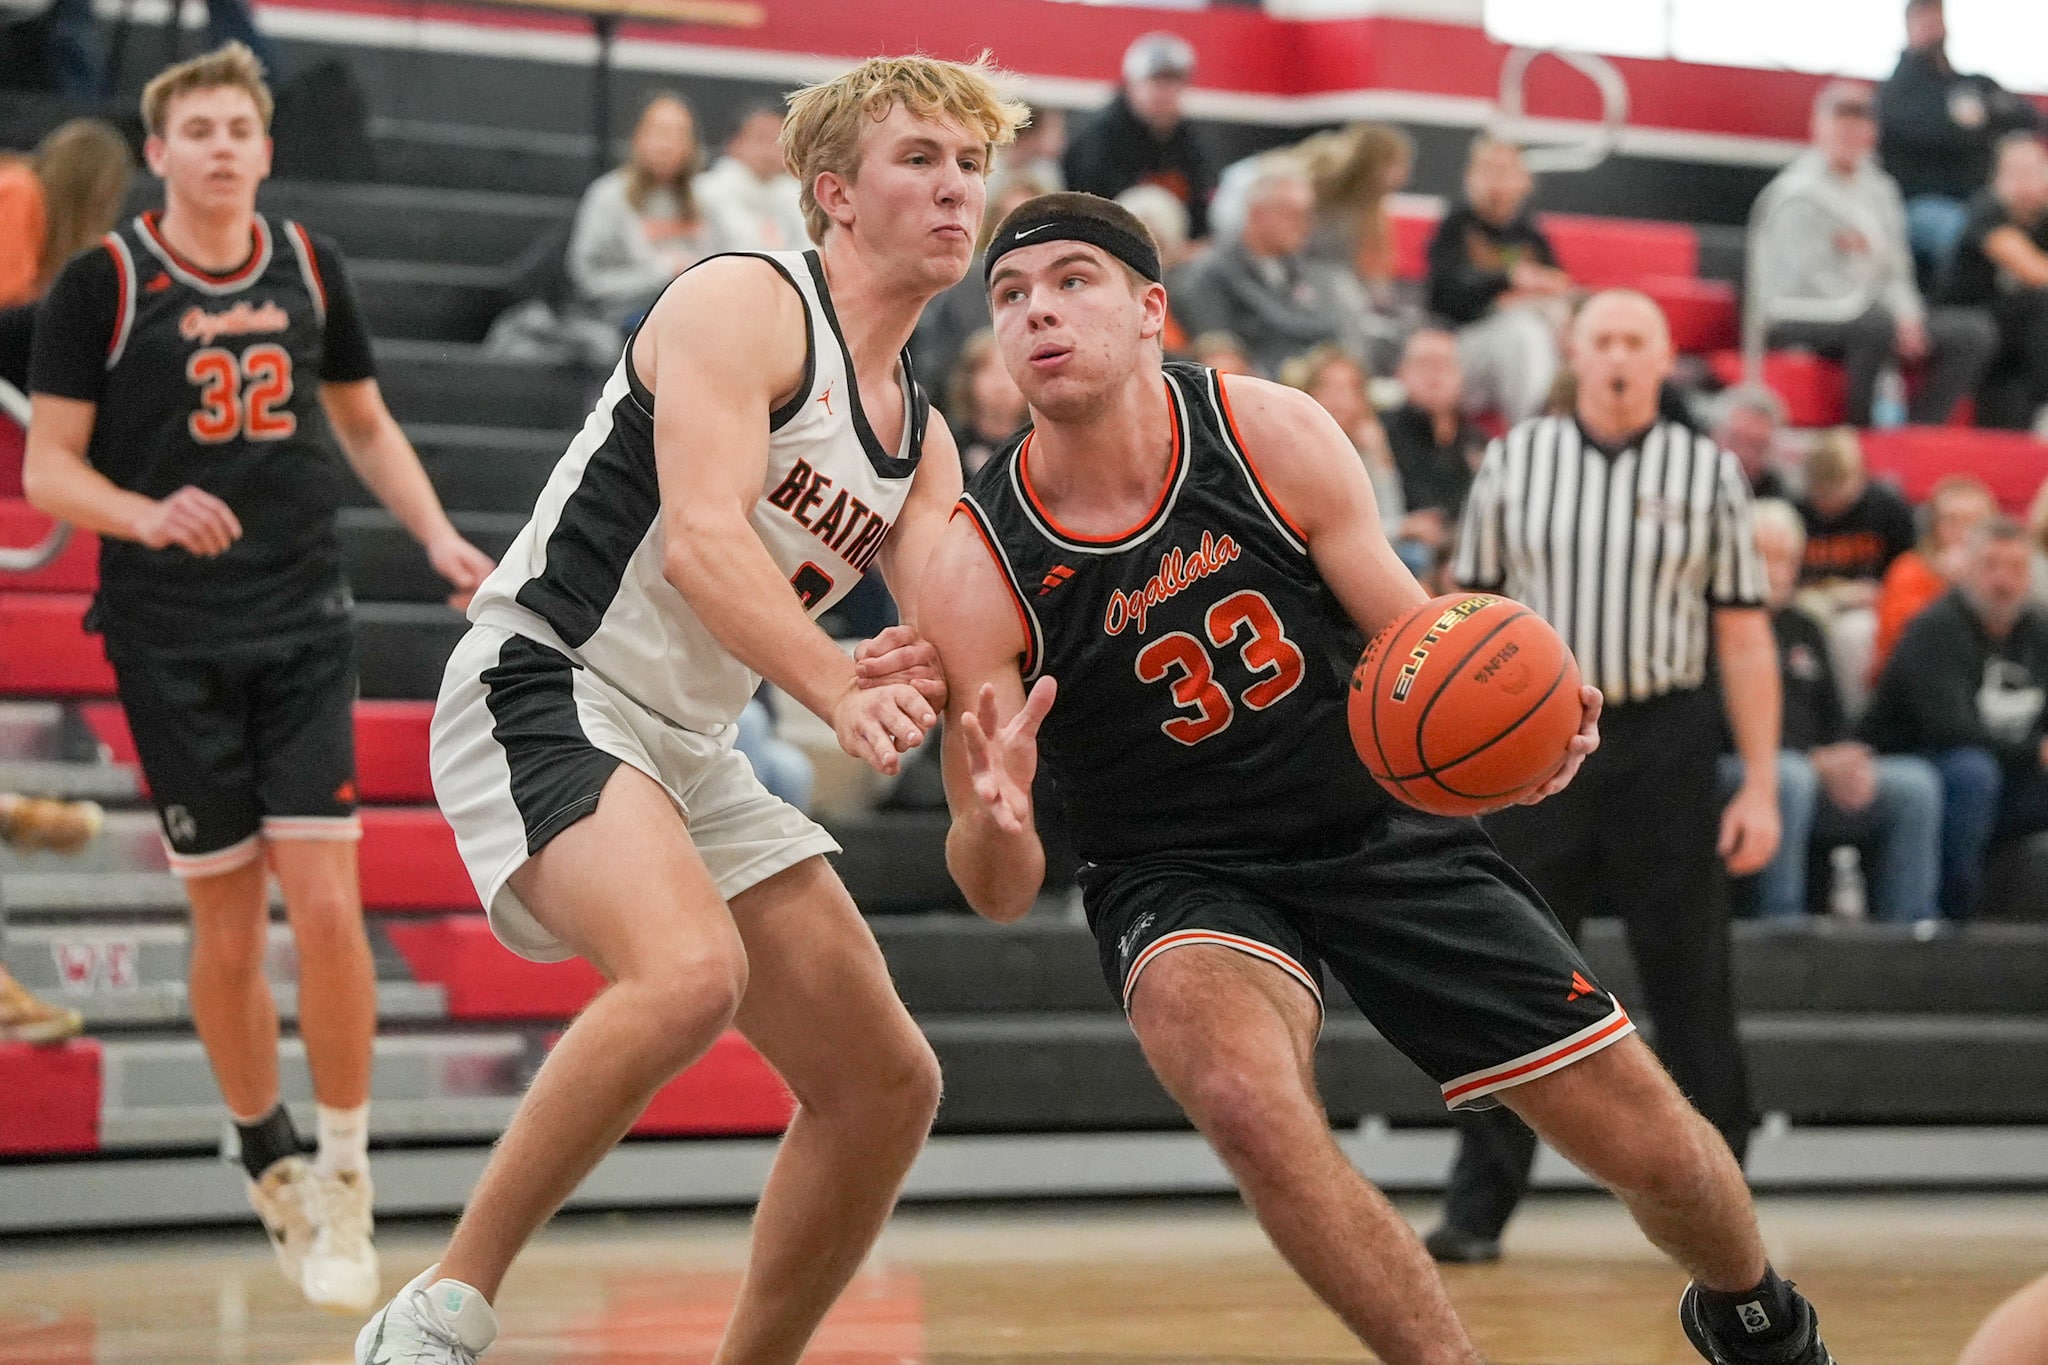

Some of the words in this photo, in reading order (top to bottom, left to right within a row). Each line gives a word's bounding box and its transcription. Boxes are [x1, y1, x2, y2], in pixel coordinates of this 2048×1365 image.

[187, 344, 297, 443] 32
[1104, 529, 1241, 636] Ogallala
[1135, 589, 1305, 746] 33
